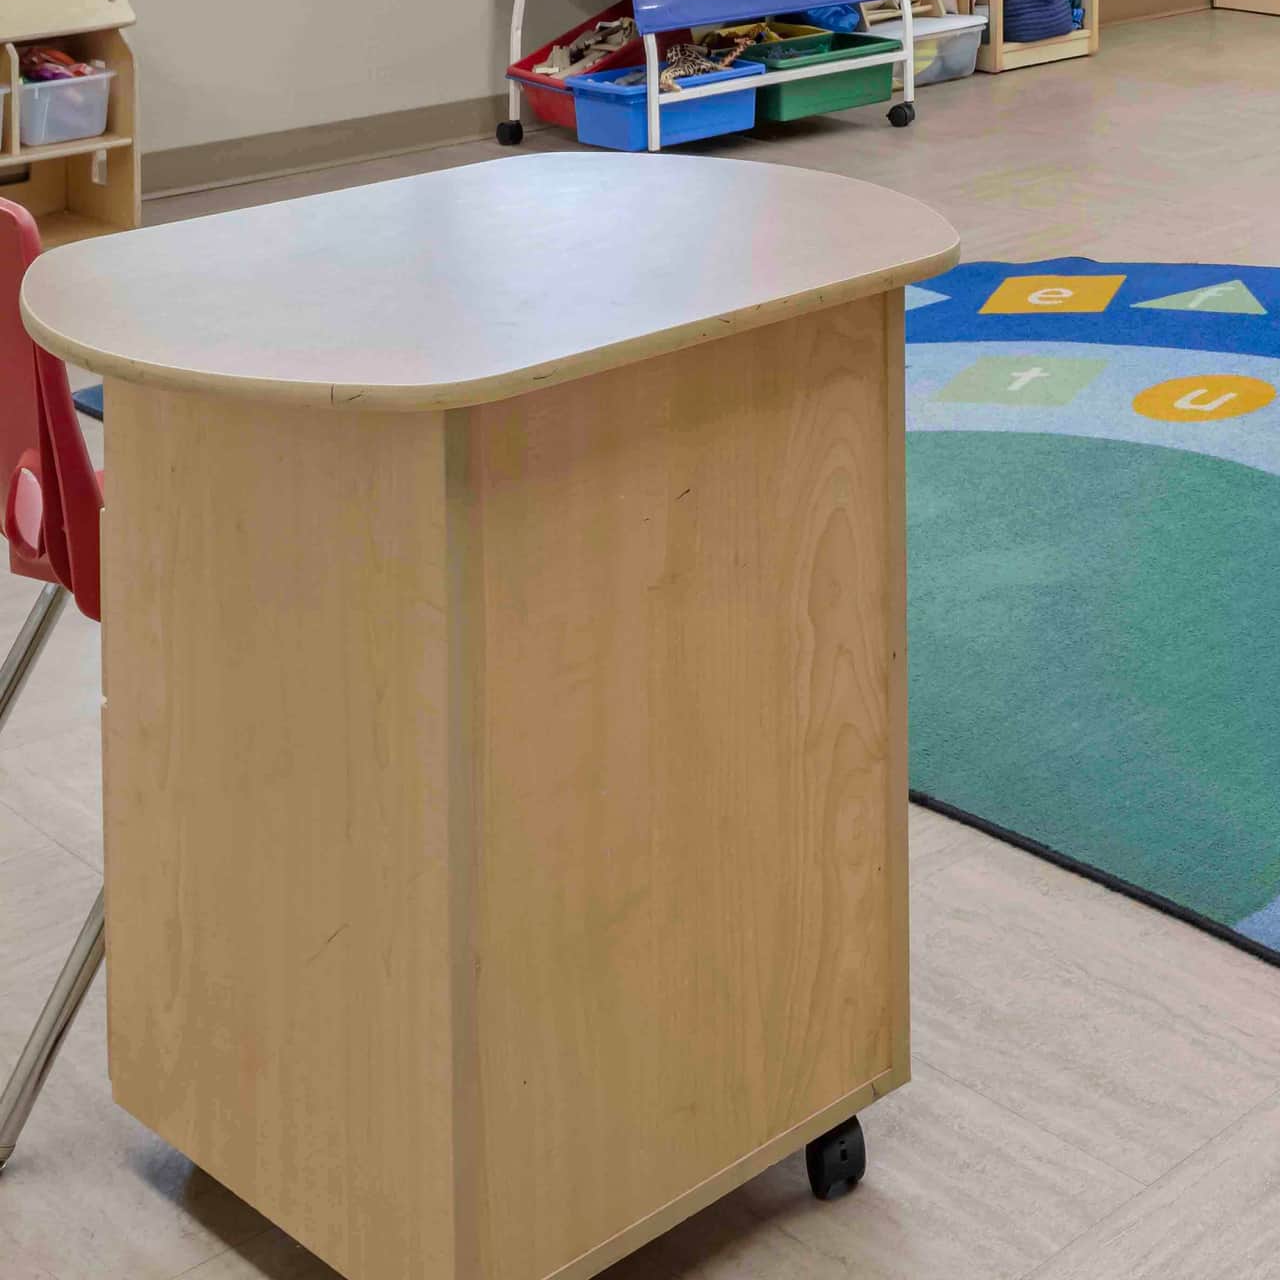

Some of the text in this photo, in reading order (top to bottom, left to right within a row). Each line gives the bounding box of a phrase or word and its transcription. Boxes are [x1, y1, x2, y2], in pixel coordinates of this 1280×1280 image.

[1027, 287, 1074, 305] e
[1188, 285, 1237, 308] f
[1007, 366, 1050, 391] t
[1173, 388, 1237, 411] u
